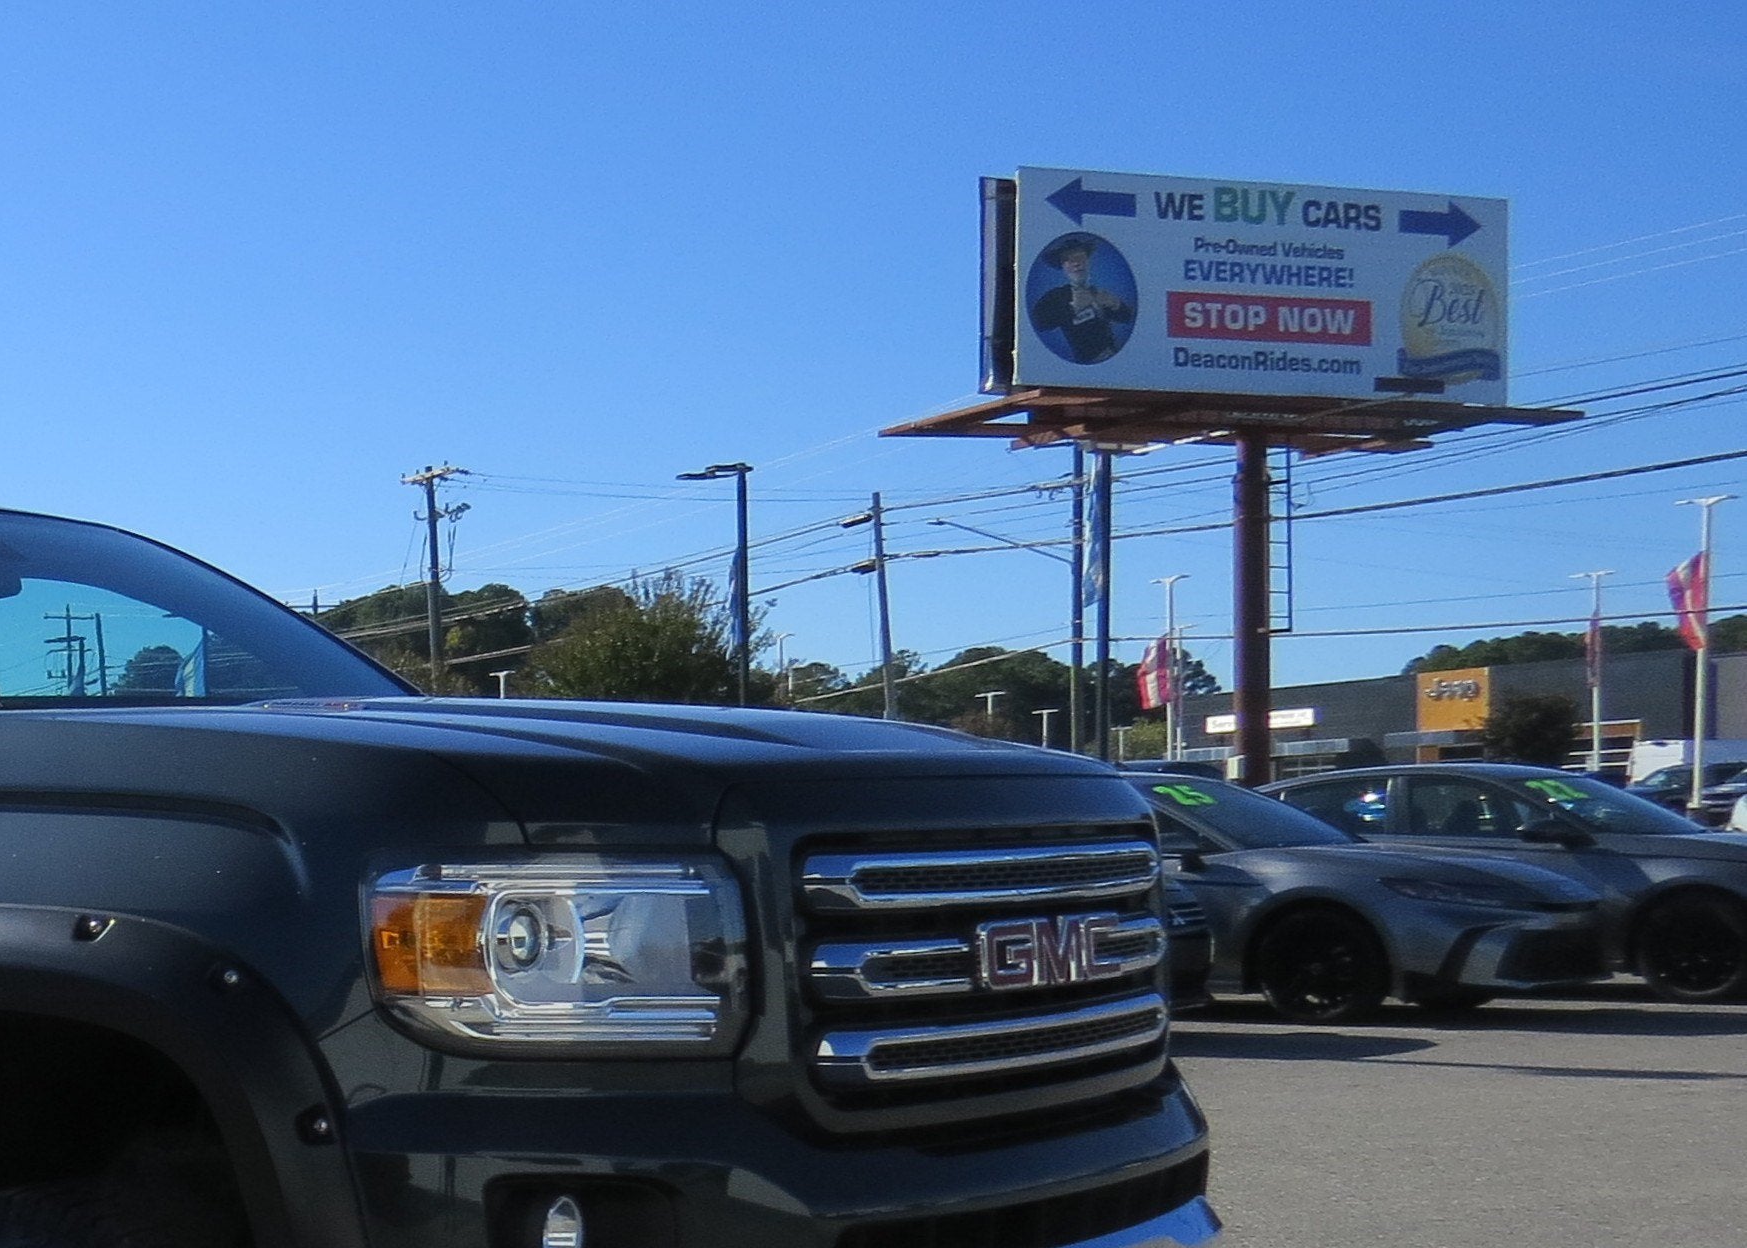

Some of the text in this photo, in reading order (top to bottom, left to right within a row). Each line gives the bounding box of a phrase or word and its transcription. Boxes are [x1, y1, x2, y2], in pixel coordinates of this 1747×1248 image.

[1154, 186, 1381, 231] WE BUY CARS
[1193, 236, 1345, 260] Pre-Owned Vehicles
[1183, 259, 1354, 288] EVERYWHERE!
[1183, 301, 1355, 335] STOP NOW
[1413, 278, 1486, 327] Best
[1172, 346, 1362, 375] DeaconRides.com
[975, 912, 1122, 990] GMC
